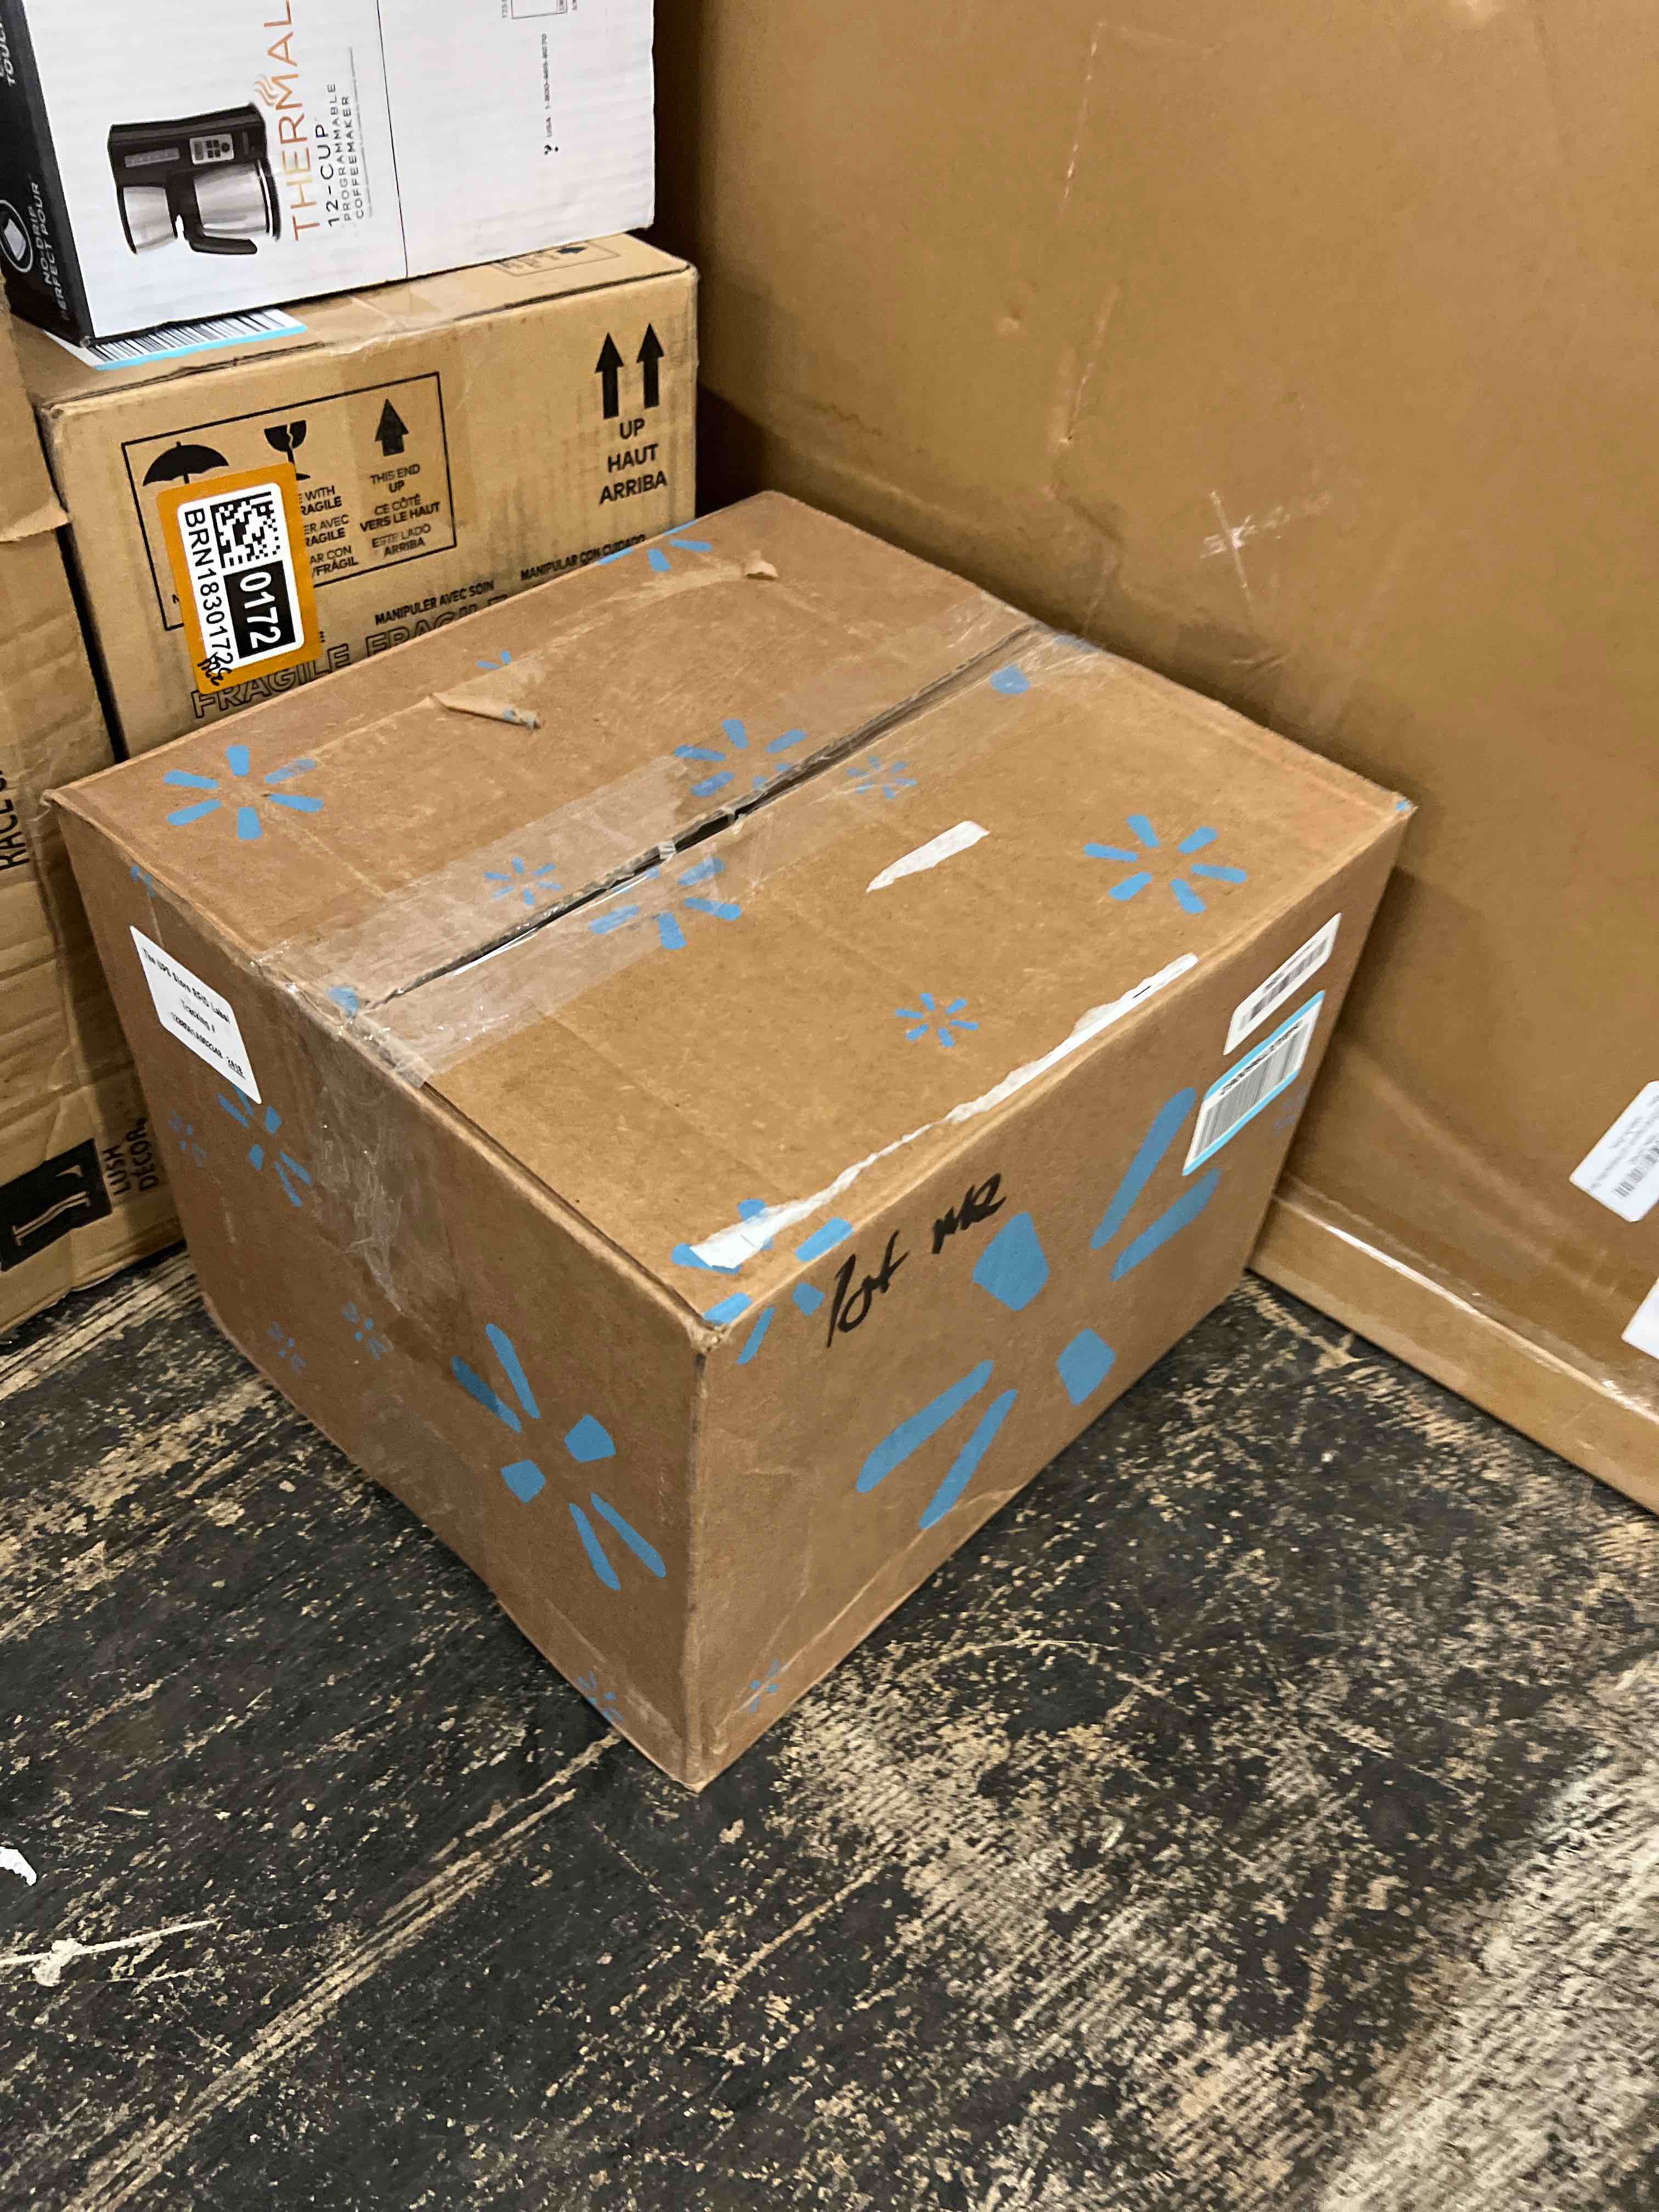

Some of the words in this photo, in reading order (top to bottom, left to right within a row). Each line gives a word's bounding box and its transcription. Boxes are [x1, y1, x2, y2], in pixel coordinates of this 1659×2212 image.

[264, 0, 320, 241] THERMAL
[328, 83, 351, 221] PROGRAMMABLE
[342, 95, 364, 219] COFFEEMAKER
[315, 123, 340, 226] 12-CUP
[31, 182, 48, 236] POUR
[28, 205, 53, 285] NO-DRIP
[44, 242, 70, 321] PERFECT
[620, 417, 645, 439] UP
[608, 443, 659, 473] HAUT
[369, 471, 395, 484] THIS
[397, 464, 421, 479] END
[389, 480, 405, 493] UP
[599, 470, 668, 505] ARRIBA
[301, 495, 342, 516] RAGILE
[304, 485, 336, 501] WITH
[320, 514, 349, 530] AVEC
[360, 516, 391, 532] VERS
[393, 511, 408, 523] LE
[410, 501, 441, 518] HAUT
[374, 504, 390, 516] CE
[305, 527, 346, 547] RAGILE
[372, 532, 398, 548] ESTE
[385, 537, 426, 557] ARRIBA
[327, 545, 352, 560] CON
[521, 554, 579, 580] MANIPULAR
[240, 572, 281, 649] 0172
[375, 597, 437, 625] MANIPULER
[439, 588, 466, 606] AVEC
[469, 580, 495, 597] SOIN
[191, 642, 351, 719] FRAGILE
